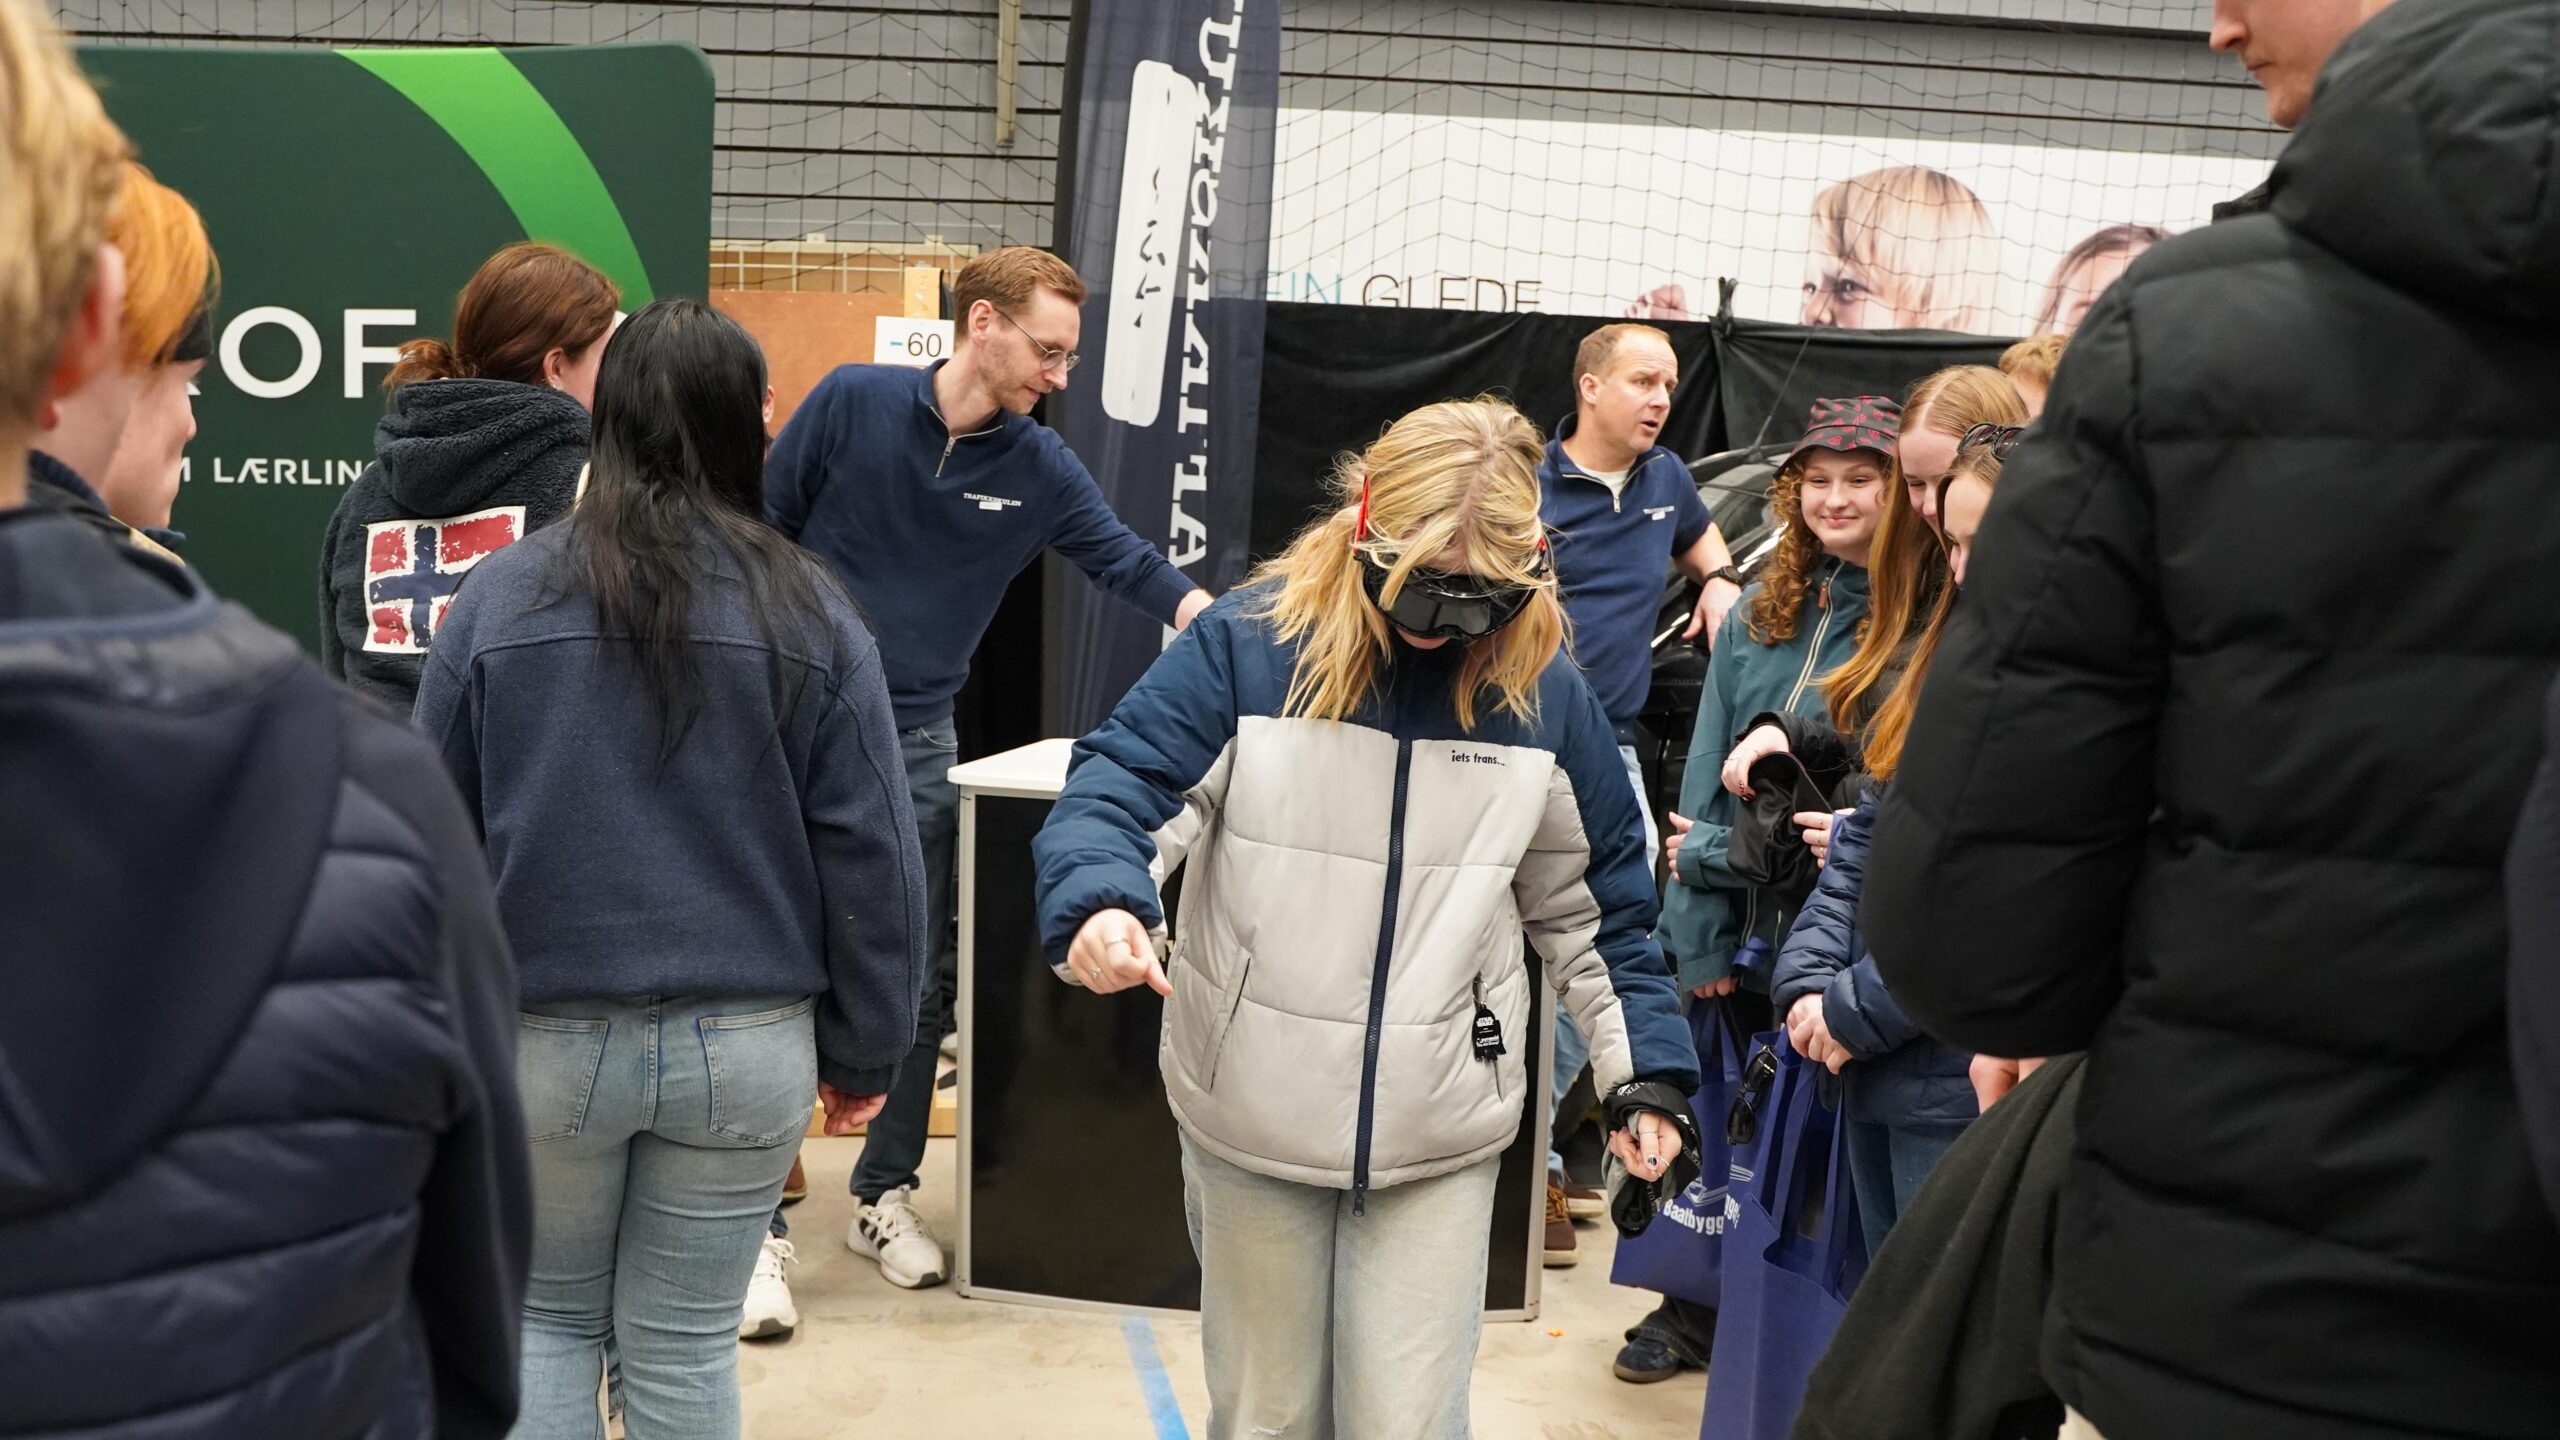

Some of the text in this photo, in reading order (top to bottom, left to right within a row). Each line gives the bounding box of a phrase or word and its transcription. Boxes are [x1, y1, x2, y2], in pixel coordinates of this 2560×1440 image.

[1362, 274, 1542, 313] GLEDE
[187, 305, 417, 399] OF
[213, 457, 374, 486] LÆRLIN
[1451, 750, 1470, 763] iets
